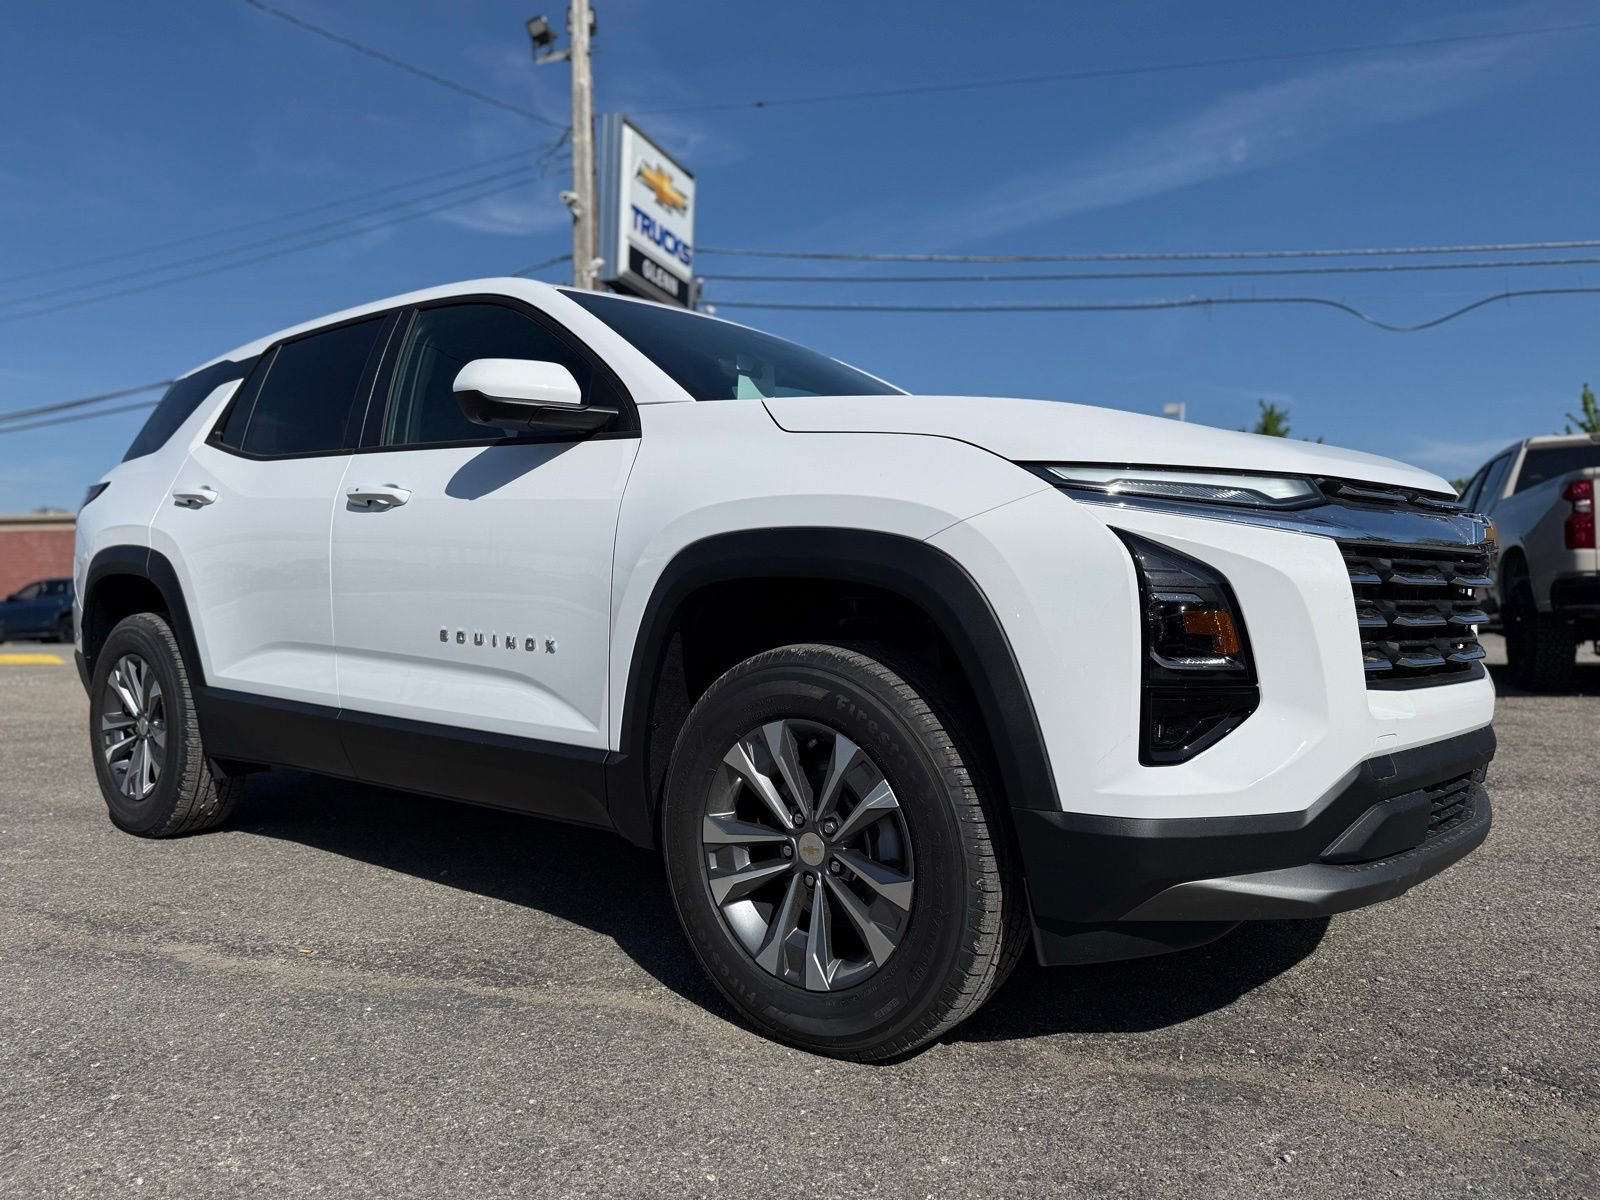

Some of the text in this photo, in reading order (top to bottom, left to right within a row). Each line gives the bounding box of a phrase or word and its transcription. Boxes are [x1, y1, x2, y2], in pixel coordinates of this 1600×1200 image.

[631, 203, 690, 266] TRUCKS
[642, 258, 679, 297] GLENN
[439, 628, 556, 654] EQUINOX
